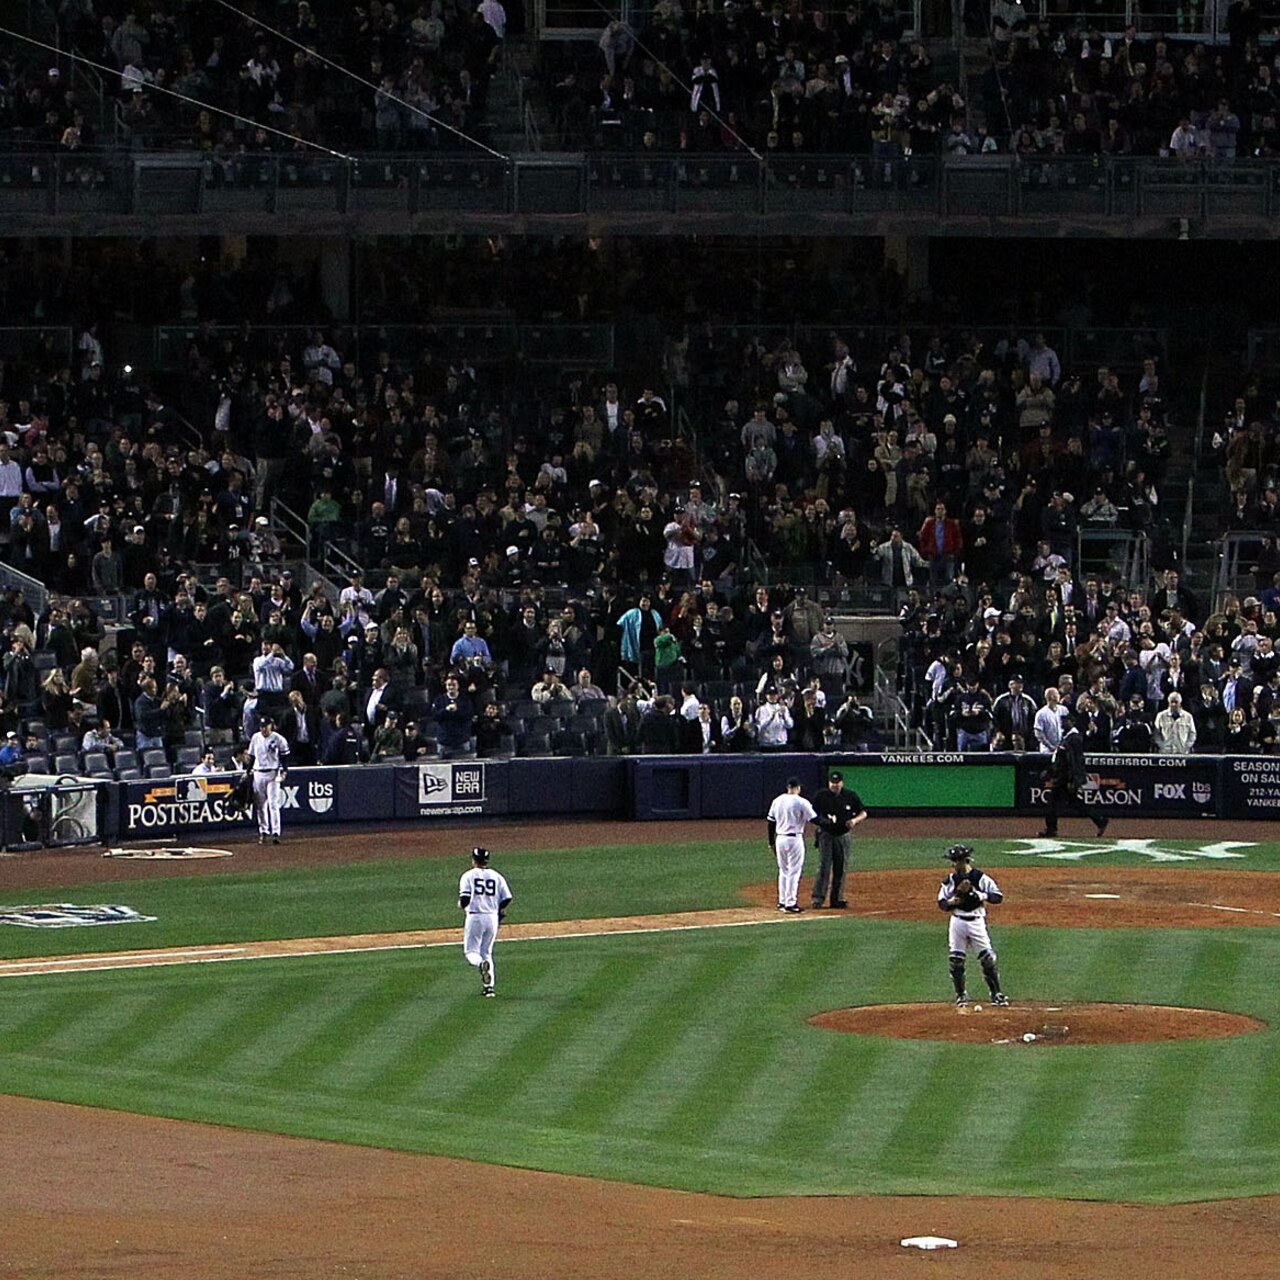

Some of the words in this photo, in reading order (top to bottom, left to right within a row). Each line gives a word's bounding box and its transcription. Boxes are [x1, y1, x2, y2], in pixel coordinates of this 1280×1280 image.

[880, 754, 964, 763] YANKEES.COM
[1084, 756, 1187, 767] EESBEISBOL.COM
[1233, 761, 1280, 772] SEASON
[455, 770, 480, 782] NEW
[1240, 773, 1259, 784] ON
[308, 781, 334, 798] tbs
[455, 782, 480, 794] ERA
[1153, 783, 1186, 800] FOX
[1192, 781, 1212, 793] tbs
[473, 877, 497, 897] 59
